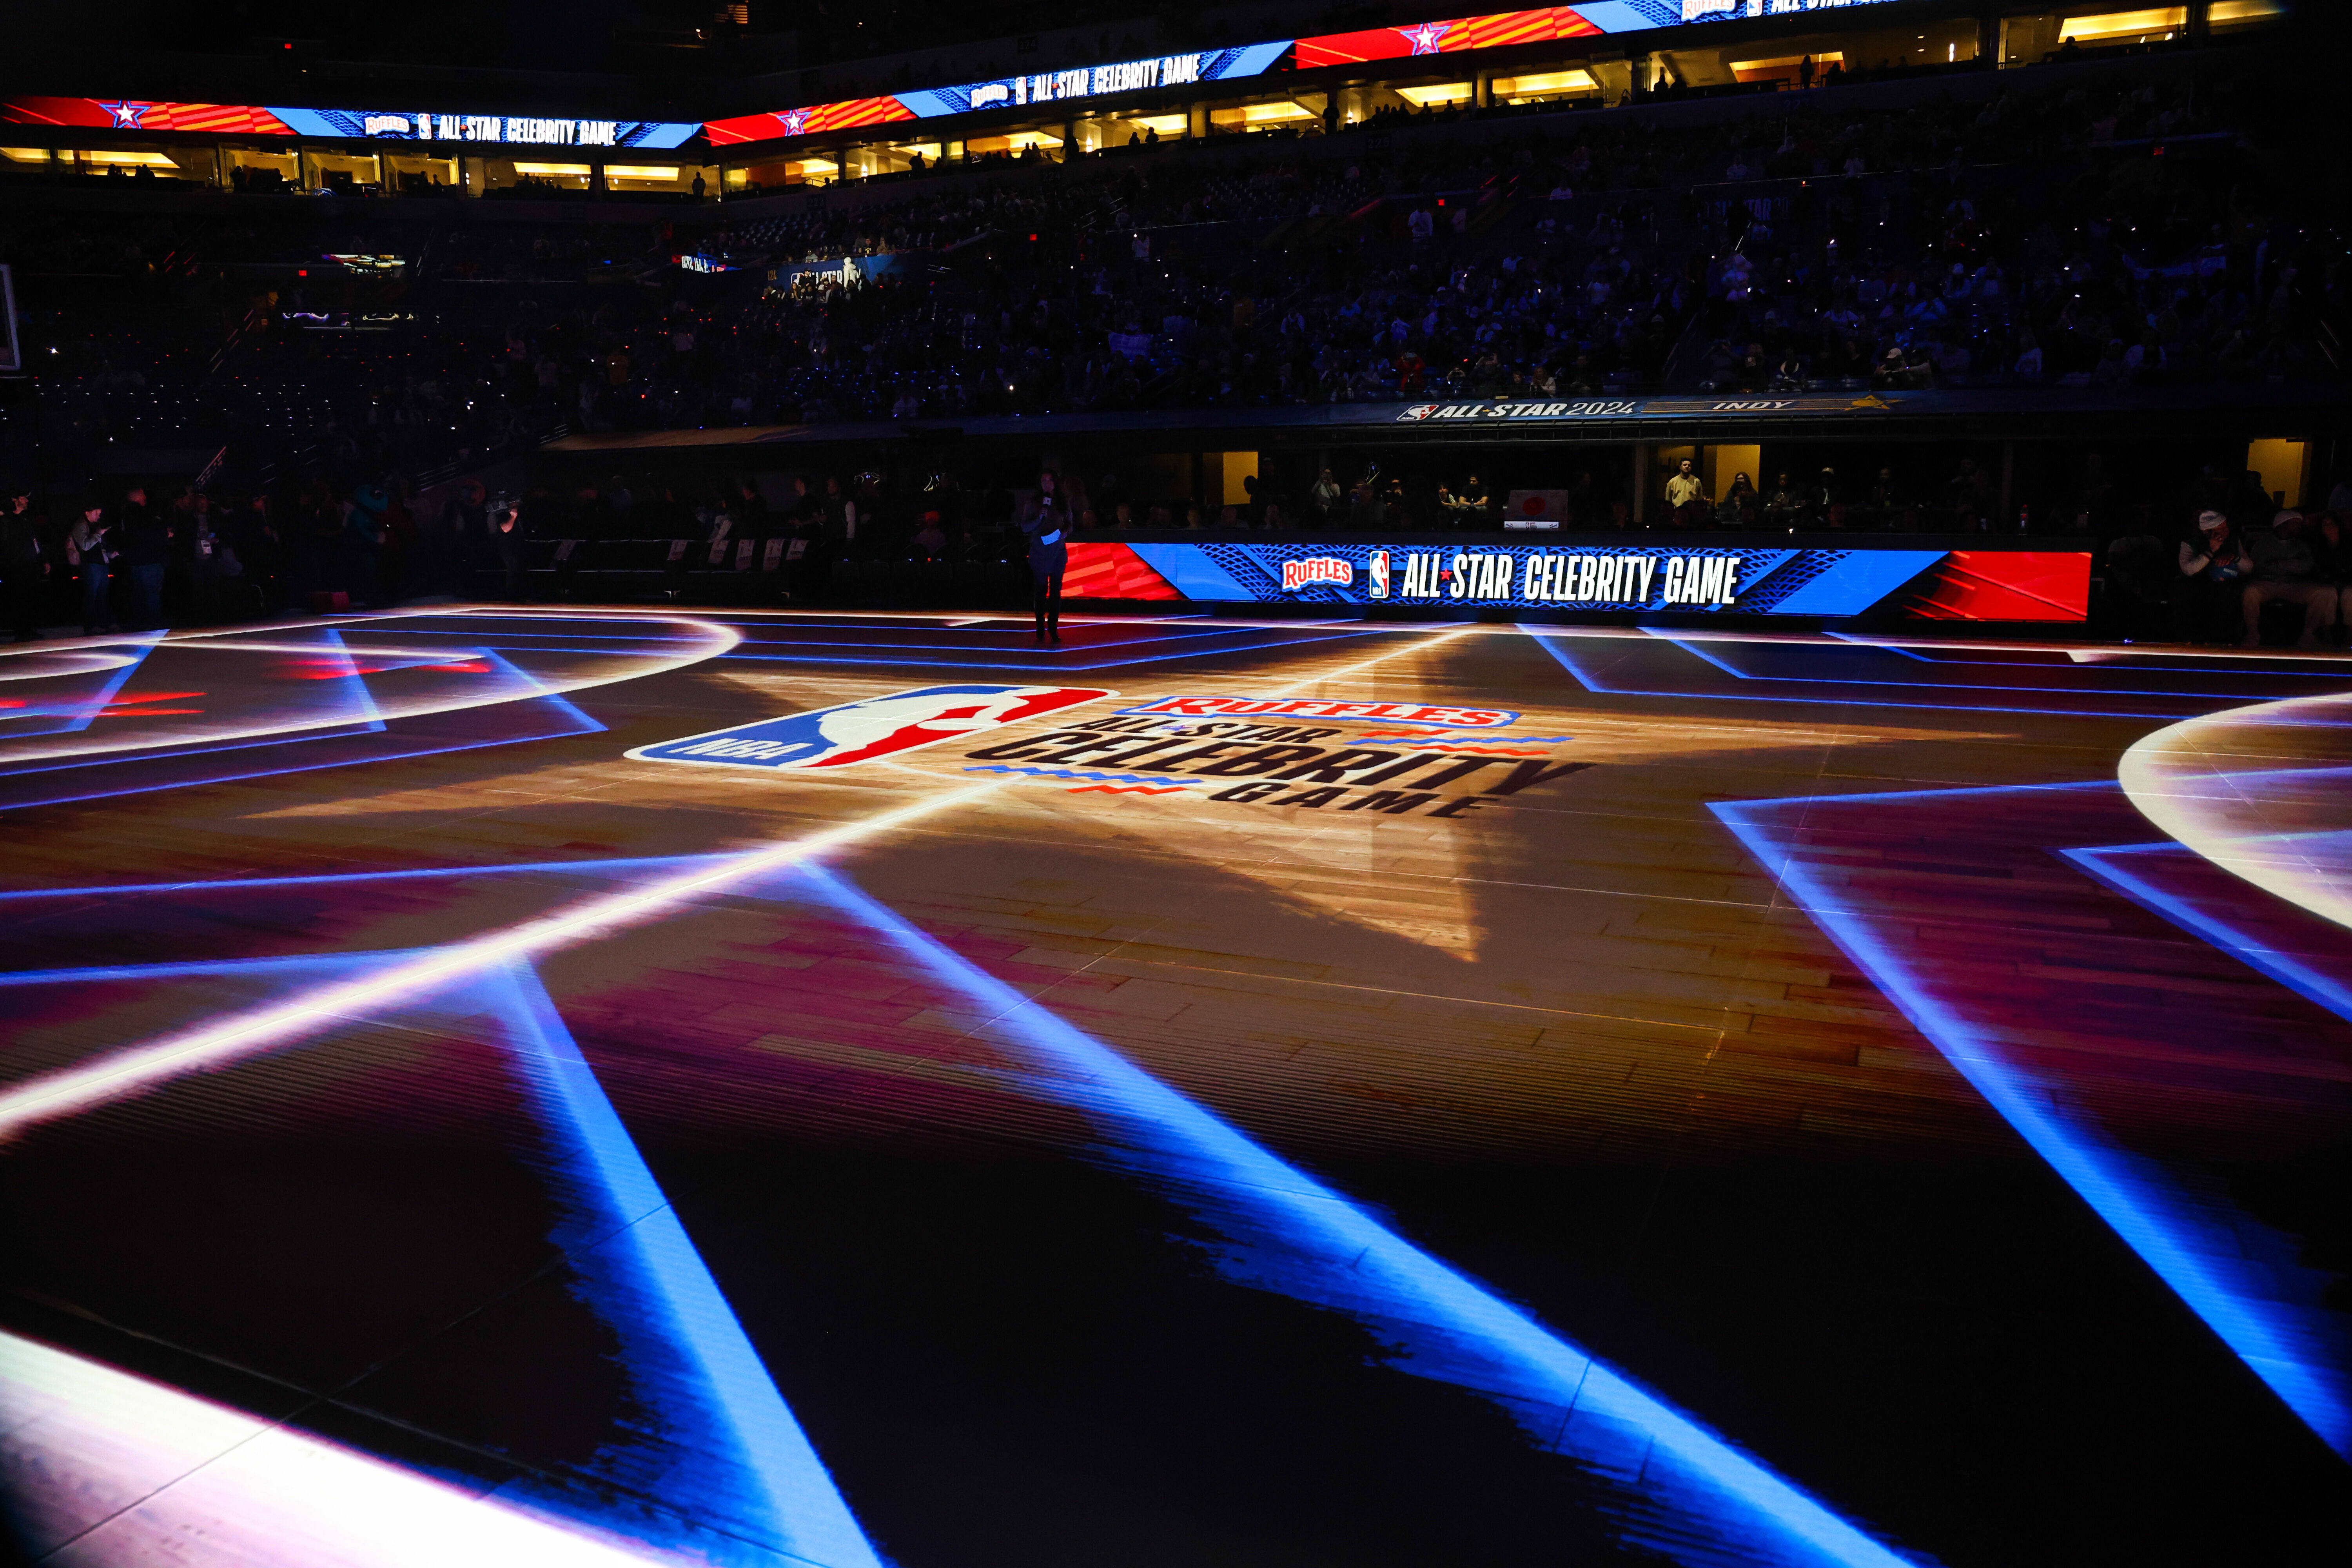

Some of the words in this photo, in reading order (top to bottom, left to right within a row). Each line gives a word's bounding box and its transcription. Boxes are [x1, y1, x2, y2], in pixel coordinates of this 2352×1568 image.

[1033, 74, 1053, 101] ALL
[1057, 69, 1088, 98] STAR
[1094, 59, 1159, 94] CELEBRITY
[1163, 54, 1200, 83] GAME
[973, 87, 1006, 104] RUFFLES
[367, 118, 407, 131] RUFFLES
[438, 115, 462, 140] ALL
[466, 116, 501, 141] STAR
[507, 118, 576, 144] CELEBRITY
[579, 122, 616, 145] GAME
[1432, 405, 1485, 418] ALL
[1487, 403, 1568, 417] STAR
[1568, 401, 1637, 415] 2024
[1712, 401, 1794, 410] INDY
[1285, 559, 1350, 587] RUFFLES
[1401, 553, 1441, 598] ALL
[1450, 554, 1512, 599] STAR
[1524, 555, 1657, 602] CELEBRITY
[1664, 556, 1740, 604] GAME
[1372, 587, 1382, 595] NBA
[1141, 697, 1502, 725] RUFFLES
[1062, 717, 1182, 734] ALL
[1171, 722, 1342, 744] STAR
[666, 738, 813, 760] NBA
[965, 732, 1598, 795] CELEBRITY
[1208, 782, 1501, 818] GAME
